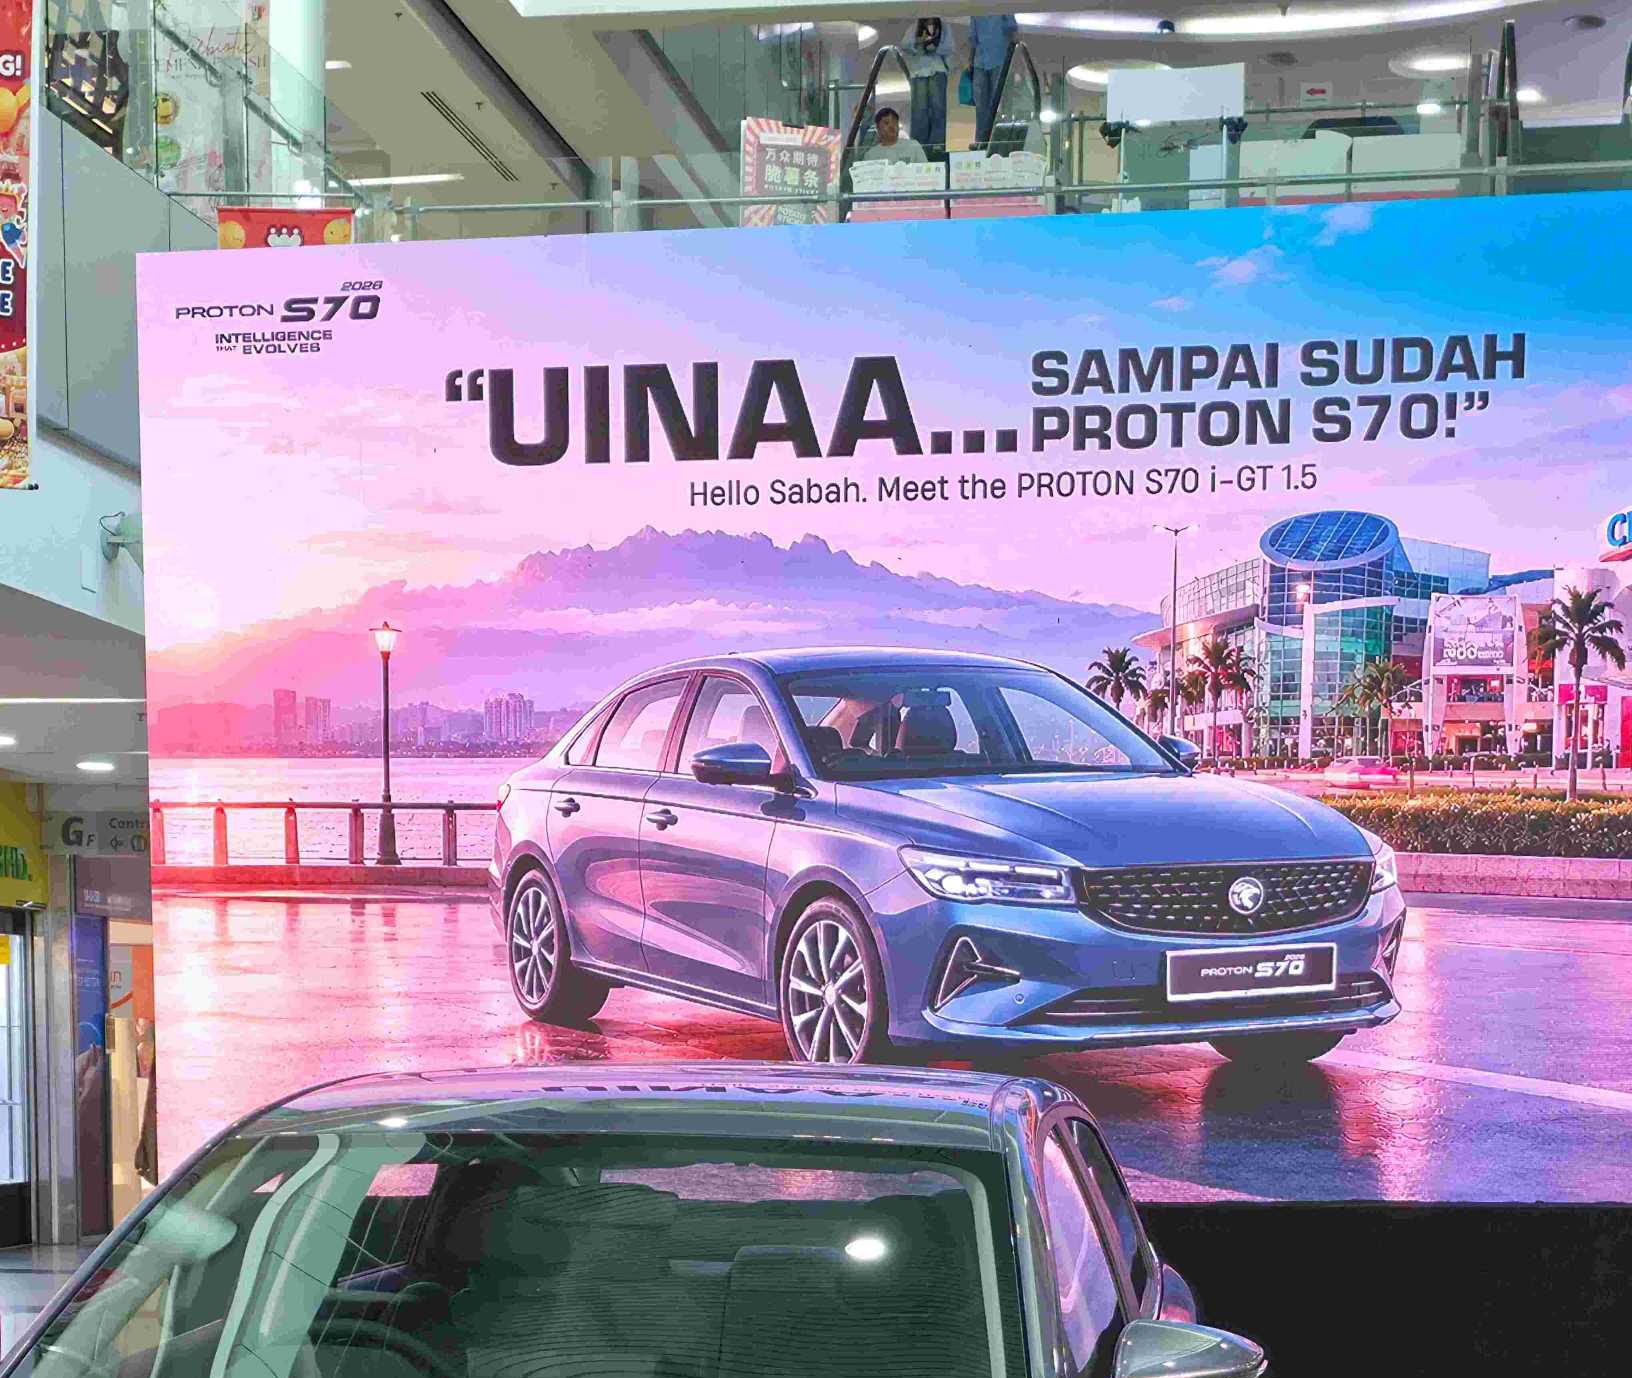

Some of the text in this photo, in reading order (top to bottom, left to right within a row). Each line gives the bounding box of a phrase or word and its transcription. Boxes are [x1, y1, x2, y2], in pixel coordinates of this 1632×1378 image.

[341, 280, 383, 292] 2026
[175, 294, 382, 323] PROTON S70
[215, 330, 333, 345] INTELLIGENCE
[243, 342, 321, 355] EVOLVES
[1030, 332, 1527, 396] SAMPAI SUDAH
[1031, 395, 1294, 453] PROTON
[689, 463, 1319, 507] Hello Sabah. Meet the PROTON S70 i-GT 1.5
[61, 816, 96, 847] G F
[1201, 960, 1305, 978] PROTON S70
